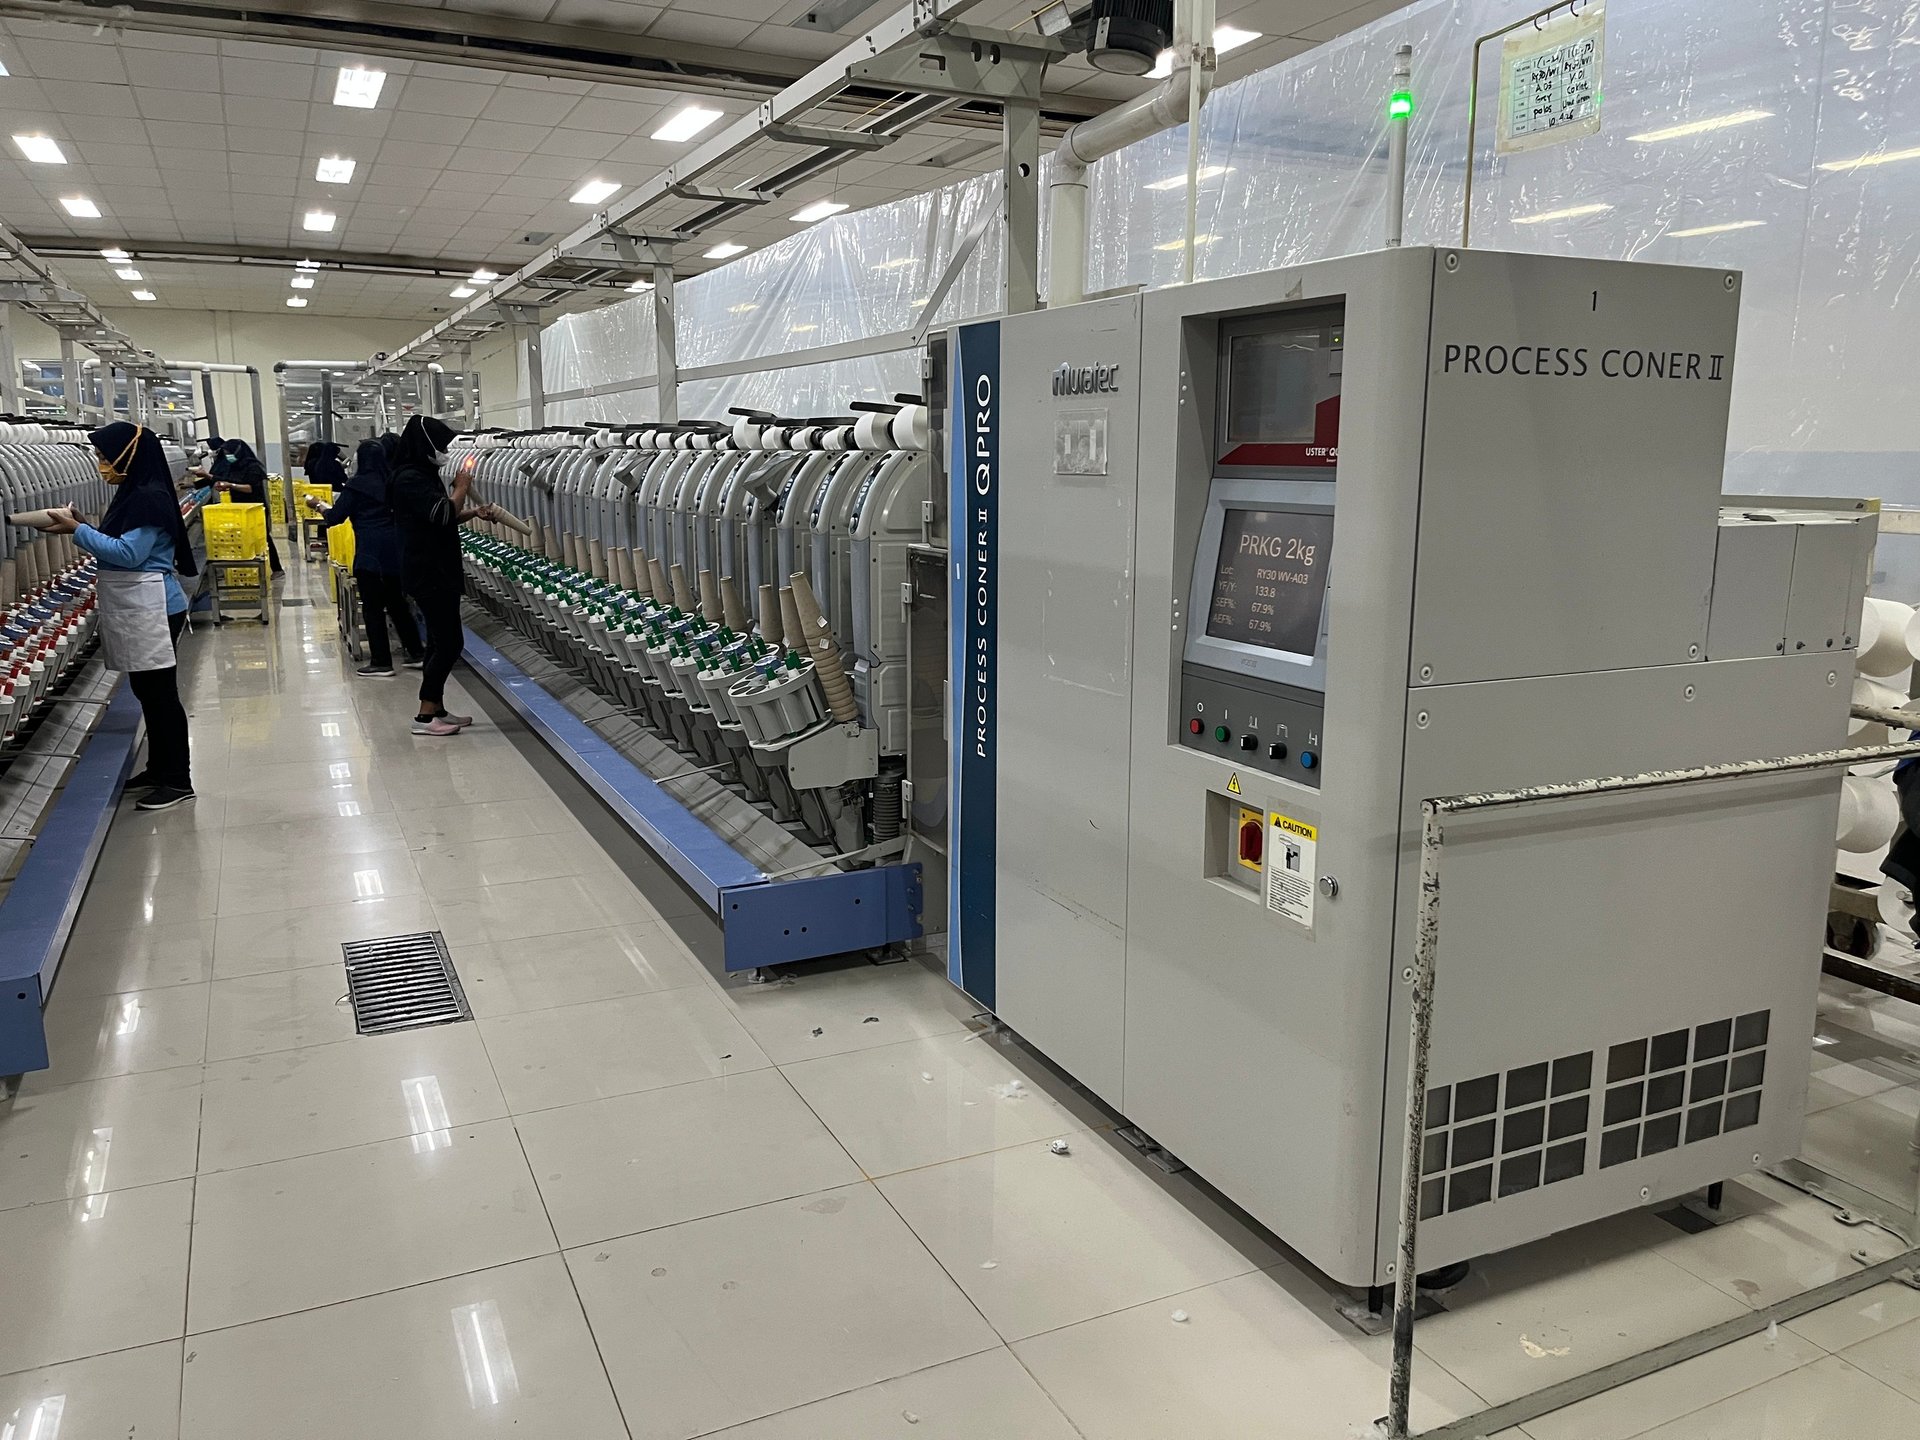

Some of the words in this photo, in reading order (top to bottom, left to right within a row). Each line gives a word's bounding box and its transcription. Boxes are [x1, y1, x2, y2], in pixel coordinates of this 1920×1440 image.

[1592, 290, 1598, 311] 1
[1444, 344, 1588, 377] PROCESS
[1601, 349, 1701, 380] CONER
[976, 374, 991, 496] QPRO
[1240, 534, 1282, 557] PRKG
[1285, 538, 1316, 566] 2kg
[976, 530, 988, 626] CONER
[1256, 568, 1277, 580] RY30
[1255, 585, 1276, 598] 133.8
[1251, 602, 1275, 616] 67.9%
[1248, 619, 1272, 633] 67.9%
[976, 637, 988, 758] PROCESS
[1282, 820, 1313, 839] CAUTION
